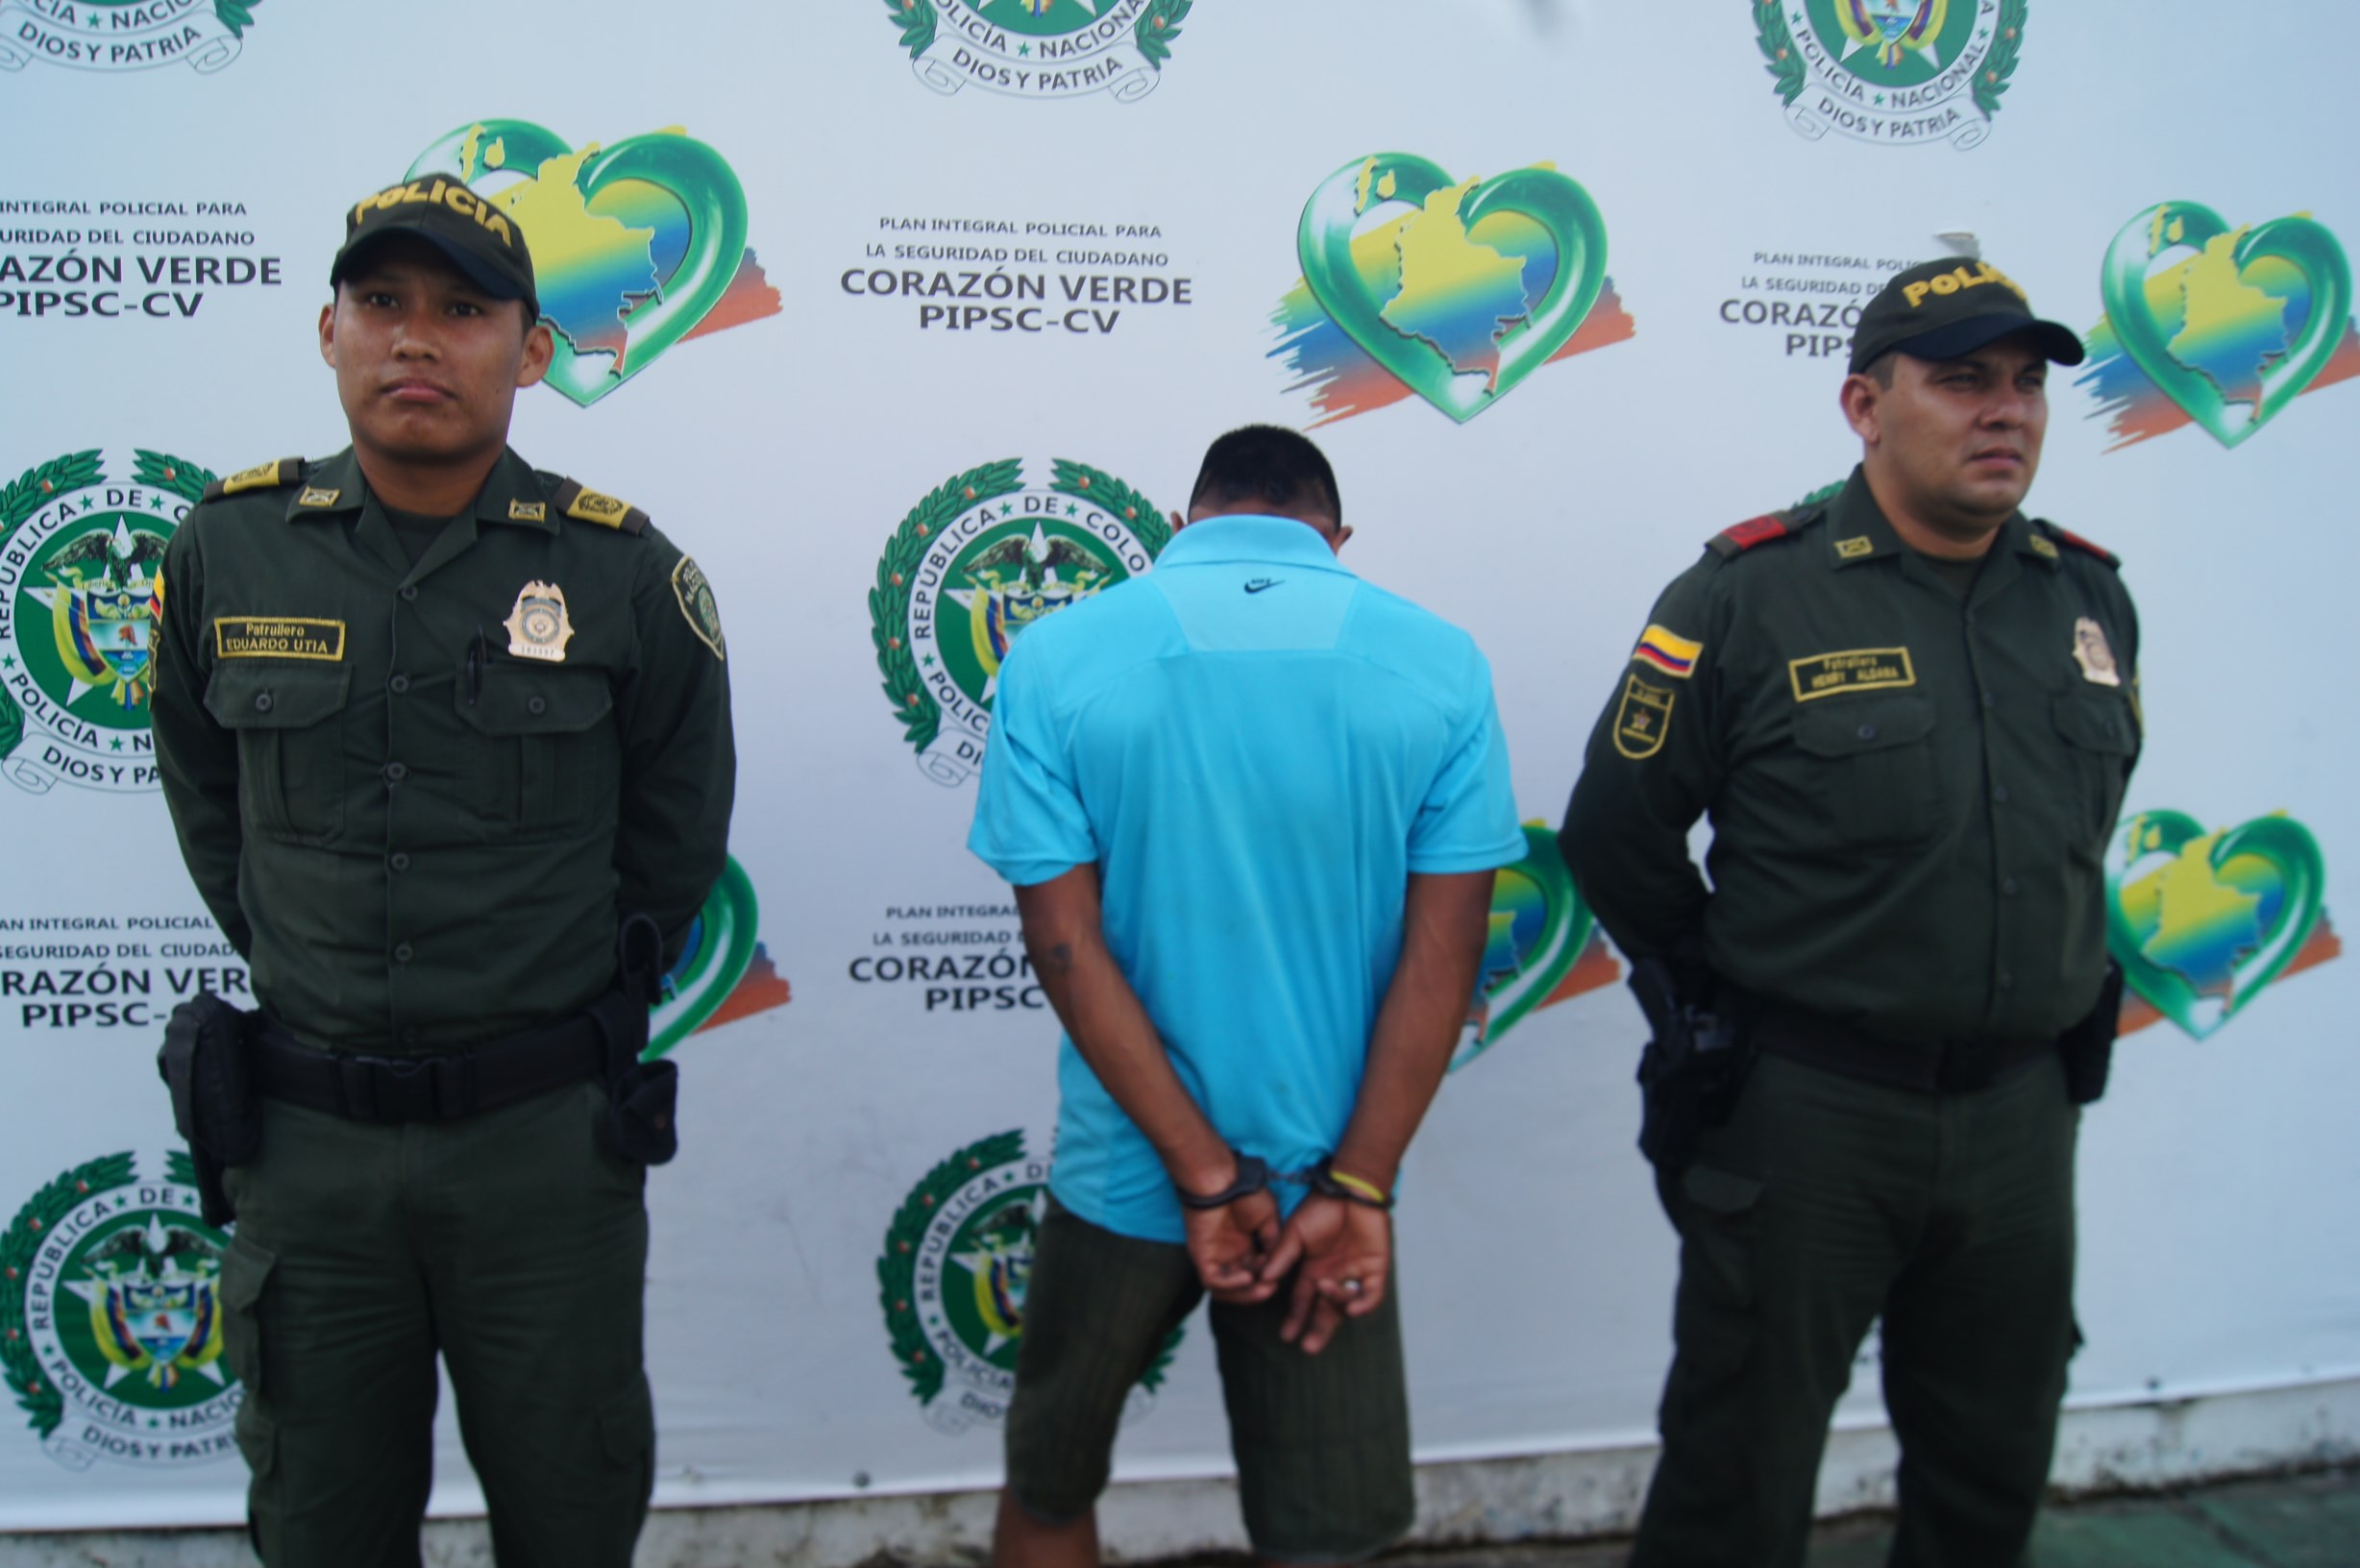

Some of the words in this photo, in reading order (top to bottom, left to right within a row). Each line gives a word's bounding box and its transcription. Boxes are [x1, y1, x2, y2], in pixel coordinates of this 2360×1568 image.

[18, 20, 81, 60] DIOS
[85, 44, 103, 62] Y
[111, 25, 202, 62] PATRIA
[952, 46, 1009, 86] DIOS
[1016, 71, 1031, 89] Y
[1039, 56, 1123, 90] PATRIA
[1890, 44, 1986, 110] NACIONAL
[1817, 96, 1867, 133] DIOS
[1872, 122, 1883, 138] Y
[1889, 107, 1961, 138] PATRIA
[0, 200, 91, 214] INTEGRAL
[100, 201, 188, 215] POLICIAL
[196, 202, 247, 216] PARA
[356, 178, 512, 248] POLICIA
[879, 217, 926, 231] PLAN
[931, 219, 1018, 234] INTEGRAL
[1026, 222, 1108, 237] POLICIAL
[1116, 225, 1162, 238] PARA
[88, 230, 124, 244] DEL
[133, 231, 256, 246] CIUDADANO
[866, 243, 886, 257] LA
[895, 245, 1008, 262] SEGURIDAD
[1015, 249, 1048, 263] DEL
[1056, 250, 1168, 267] CIUDADANO
[1754, 252, 1792, 265] PLAN
[1797, 255, 1870, 269] INTEGRAL
[0, 248, 123, 283] AZÓN
[135, 256, 283, 285] VERDE
[840, 264, 1045, 300] CORAZÓN
[1059, 275, 1192, 305] VERDE
[1741, 276, 1758, 289] LA
[1766, 278, 1861, 295] SEGURIDAD
[920, 305, 1120, 334] PIPSC-CV
[106, 488, 142, 508] DE
[1024, 496, 1059, 514] DE
[246, 623, 305, 637] Patrullero
[226, 637, 288, 651] EDUARDO
[294, 639, 328, 653] UTIA
[41, 745, 104, 782] DIOS
[108, 766, 124, 784] Y
[886, 906, 931, 919] PLAN
[30, 918, 119, 930] INTEGRAL
[127, 917, 213, 930] POLICIAL
[873, 932, 892, 946] LA
[900, 931, 1011, 946] SEGURIDAD
[0, 943, 110, 959] EGURIDAD
[116, 943, 152, 958] DEL
[1, 962, 151, 996] RAZÓN
[139, 1188, 174, 1205] DE
[83, 1426, 141, 1458] DIOS
